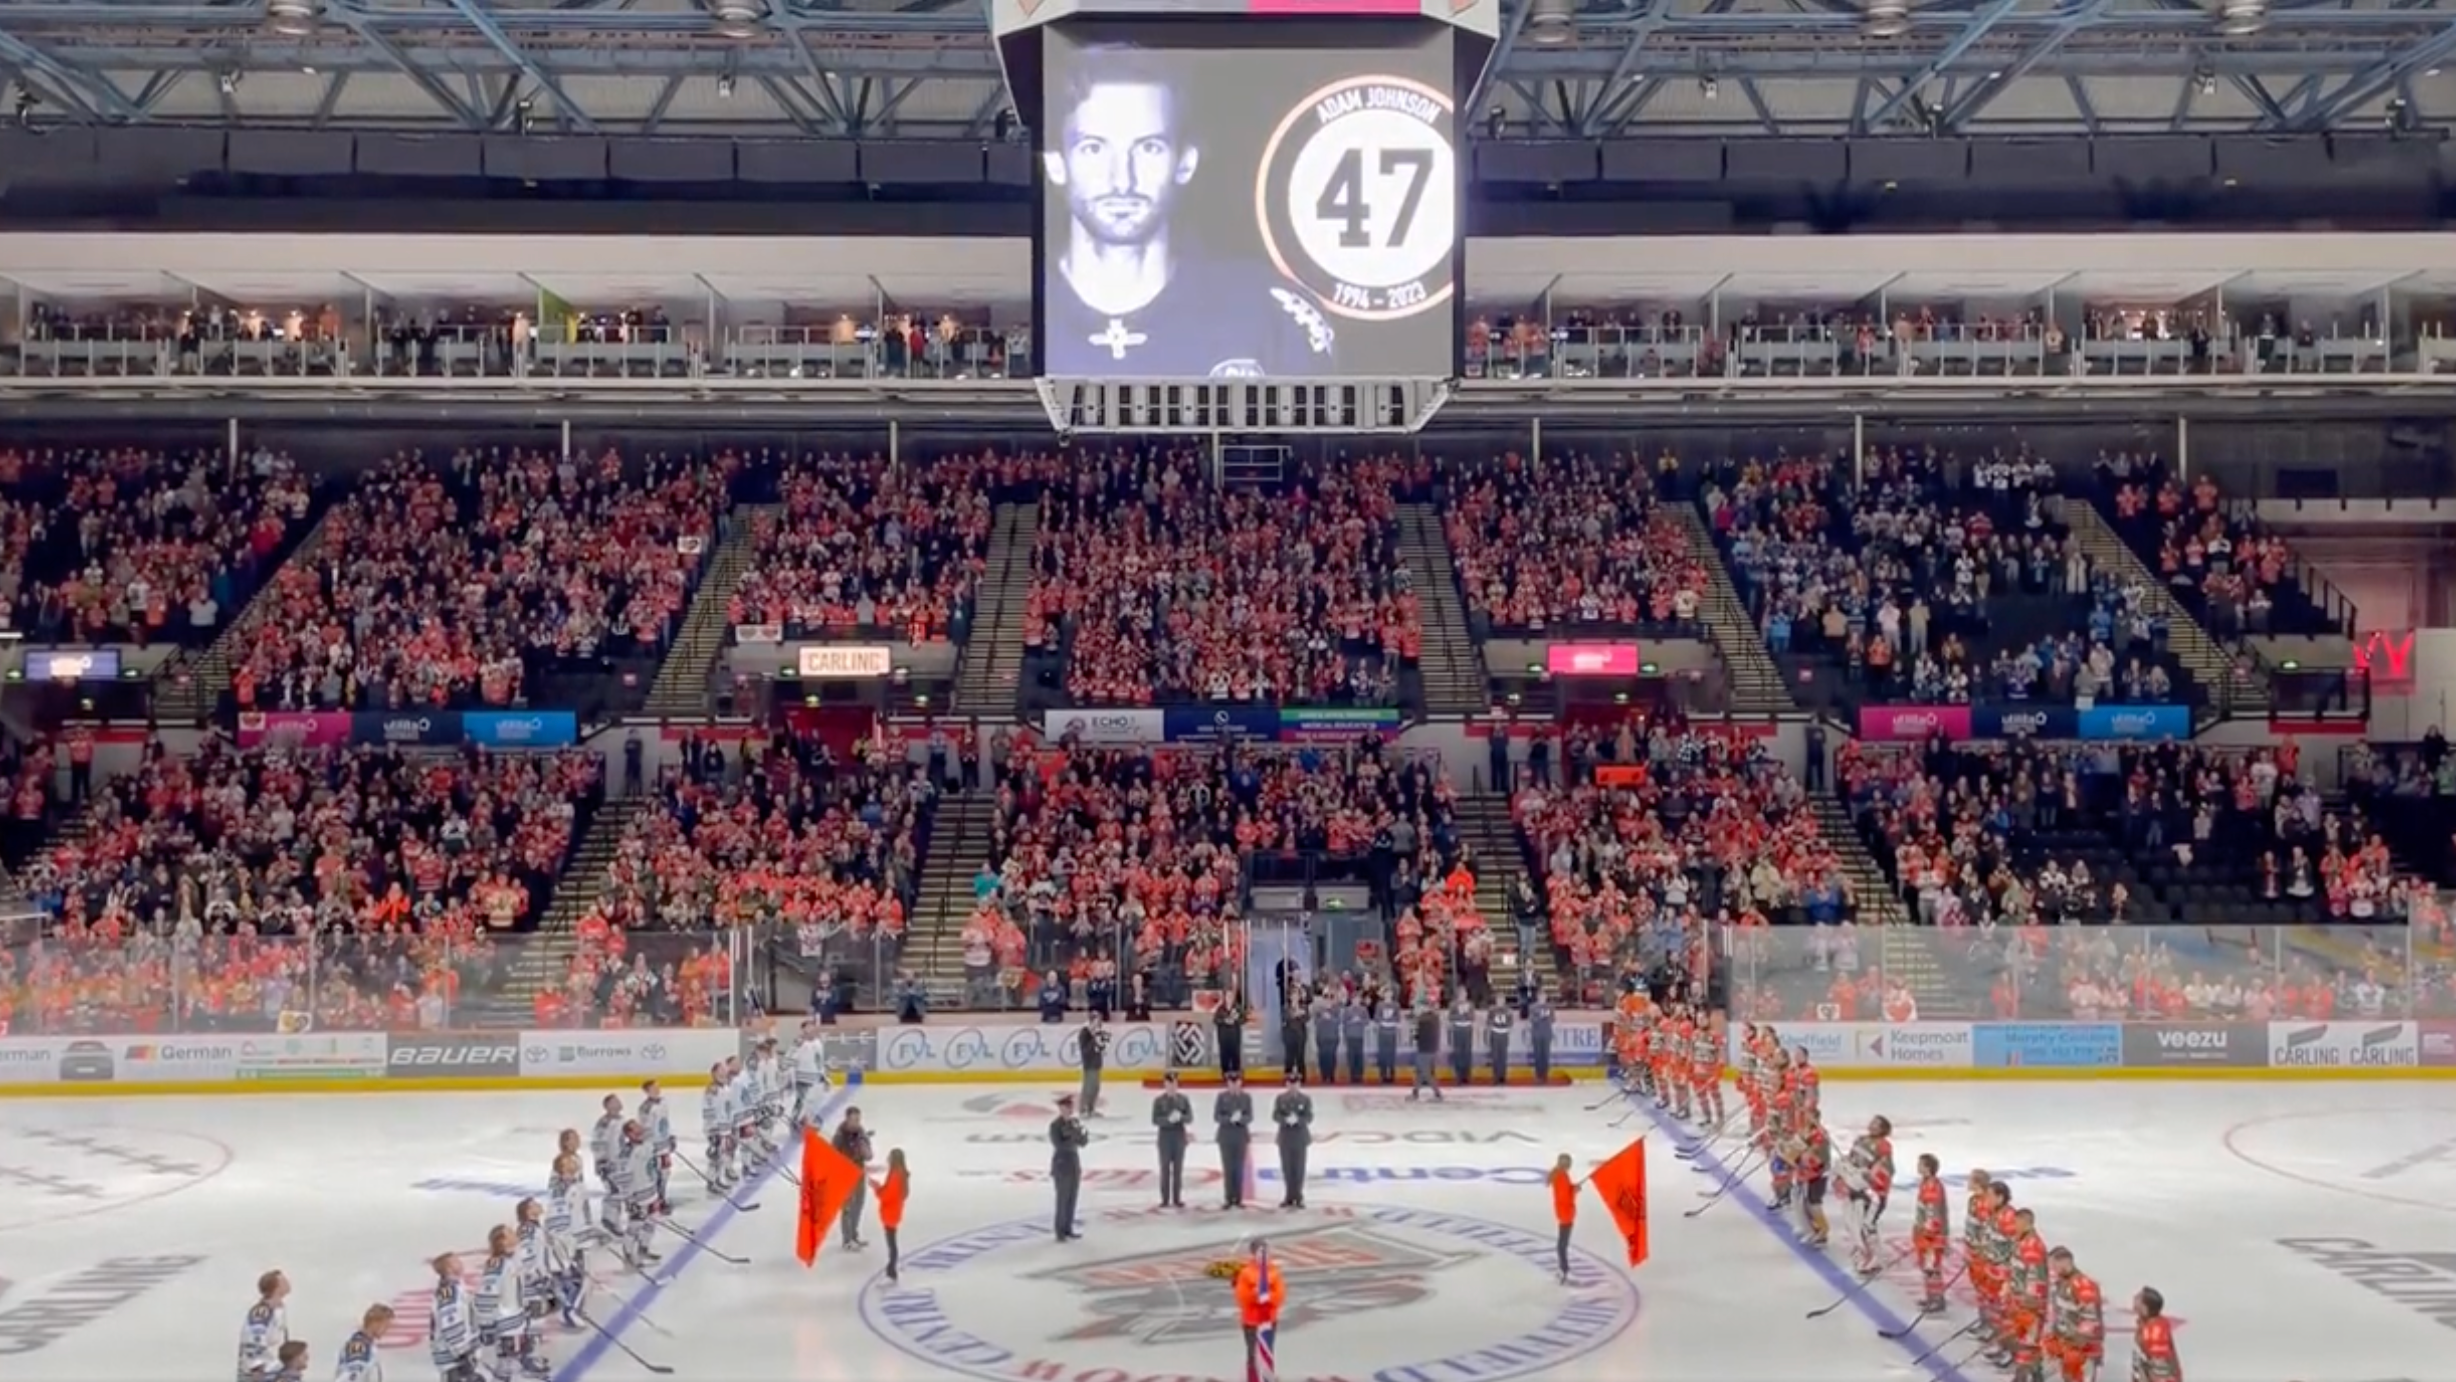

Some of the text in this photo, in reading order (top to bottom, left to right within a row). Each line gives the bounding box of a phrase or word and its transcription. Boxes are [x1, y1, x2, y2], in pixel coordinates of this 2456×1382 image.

[1316, 87, 1442, 124] ADAM JOHNSON
[1315, 148, 1434, 249] 47
[1333, 283, 1369, 309] 1994
[1387, 280, 1426, 309] 2023
[808, 654, 882, 671] CARLING
[1890, 1030, 1967, 1045] Keepmoat
[2157, 1031, 2227, 1047] veezu
[161, 1046, 232, 1060] German
[577, 1045, 632, 1057] Burrows
[1891, 1048, 1944, 1060] Homes
[2275, 1048, 2339, 1065] CARLING
[2351, 1048, 2415, 1065] CARLING
